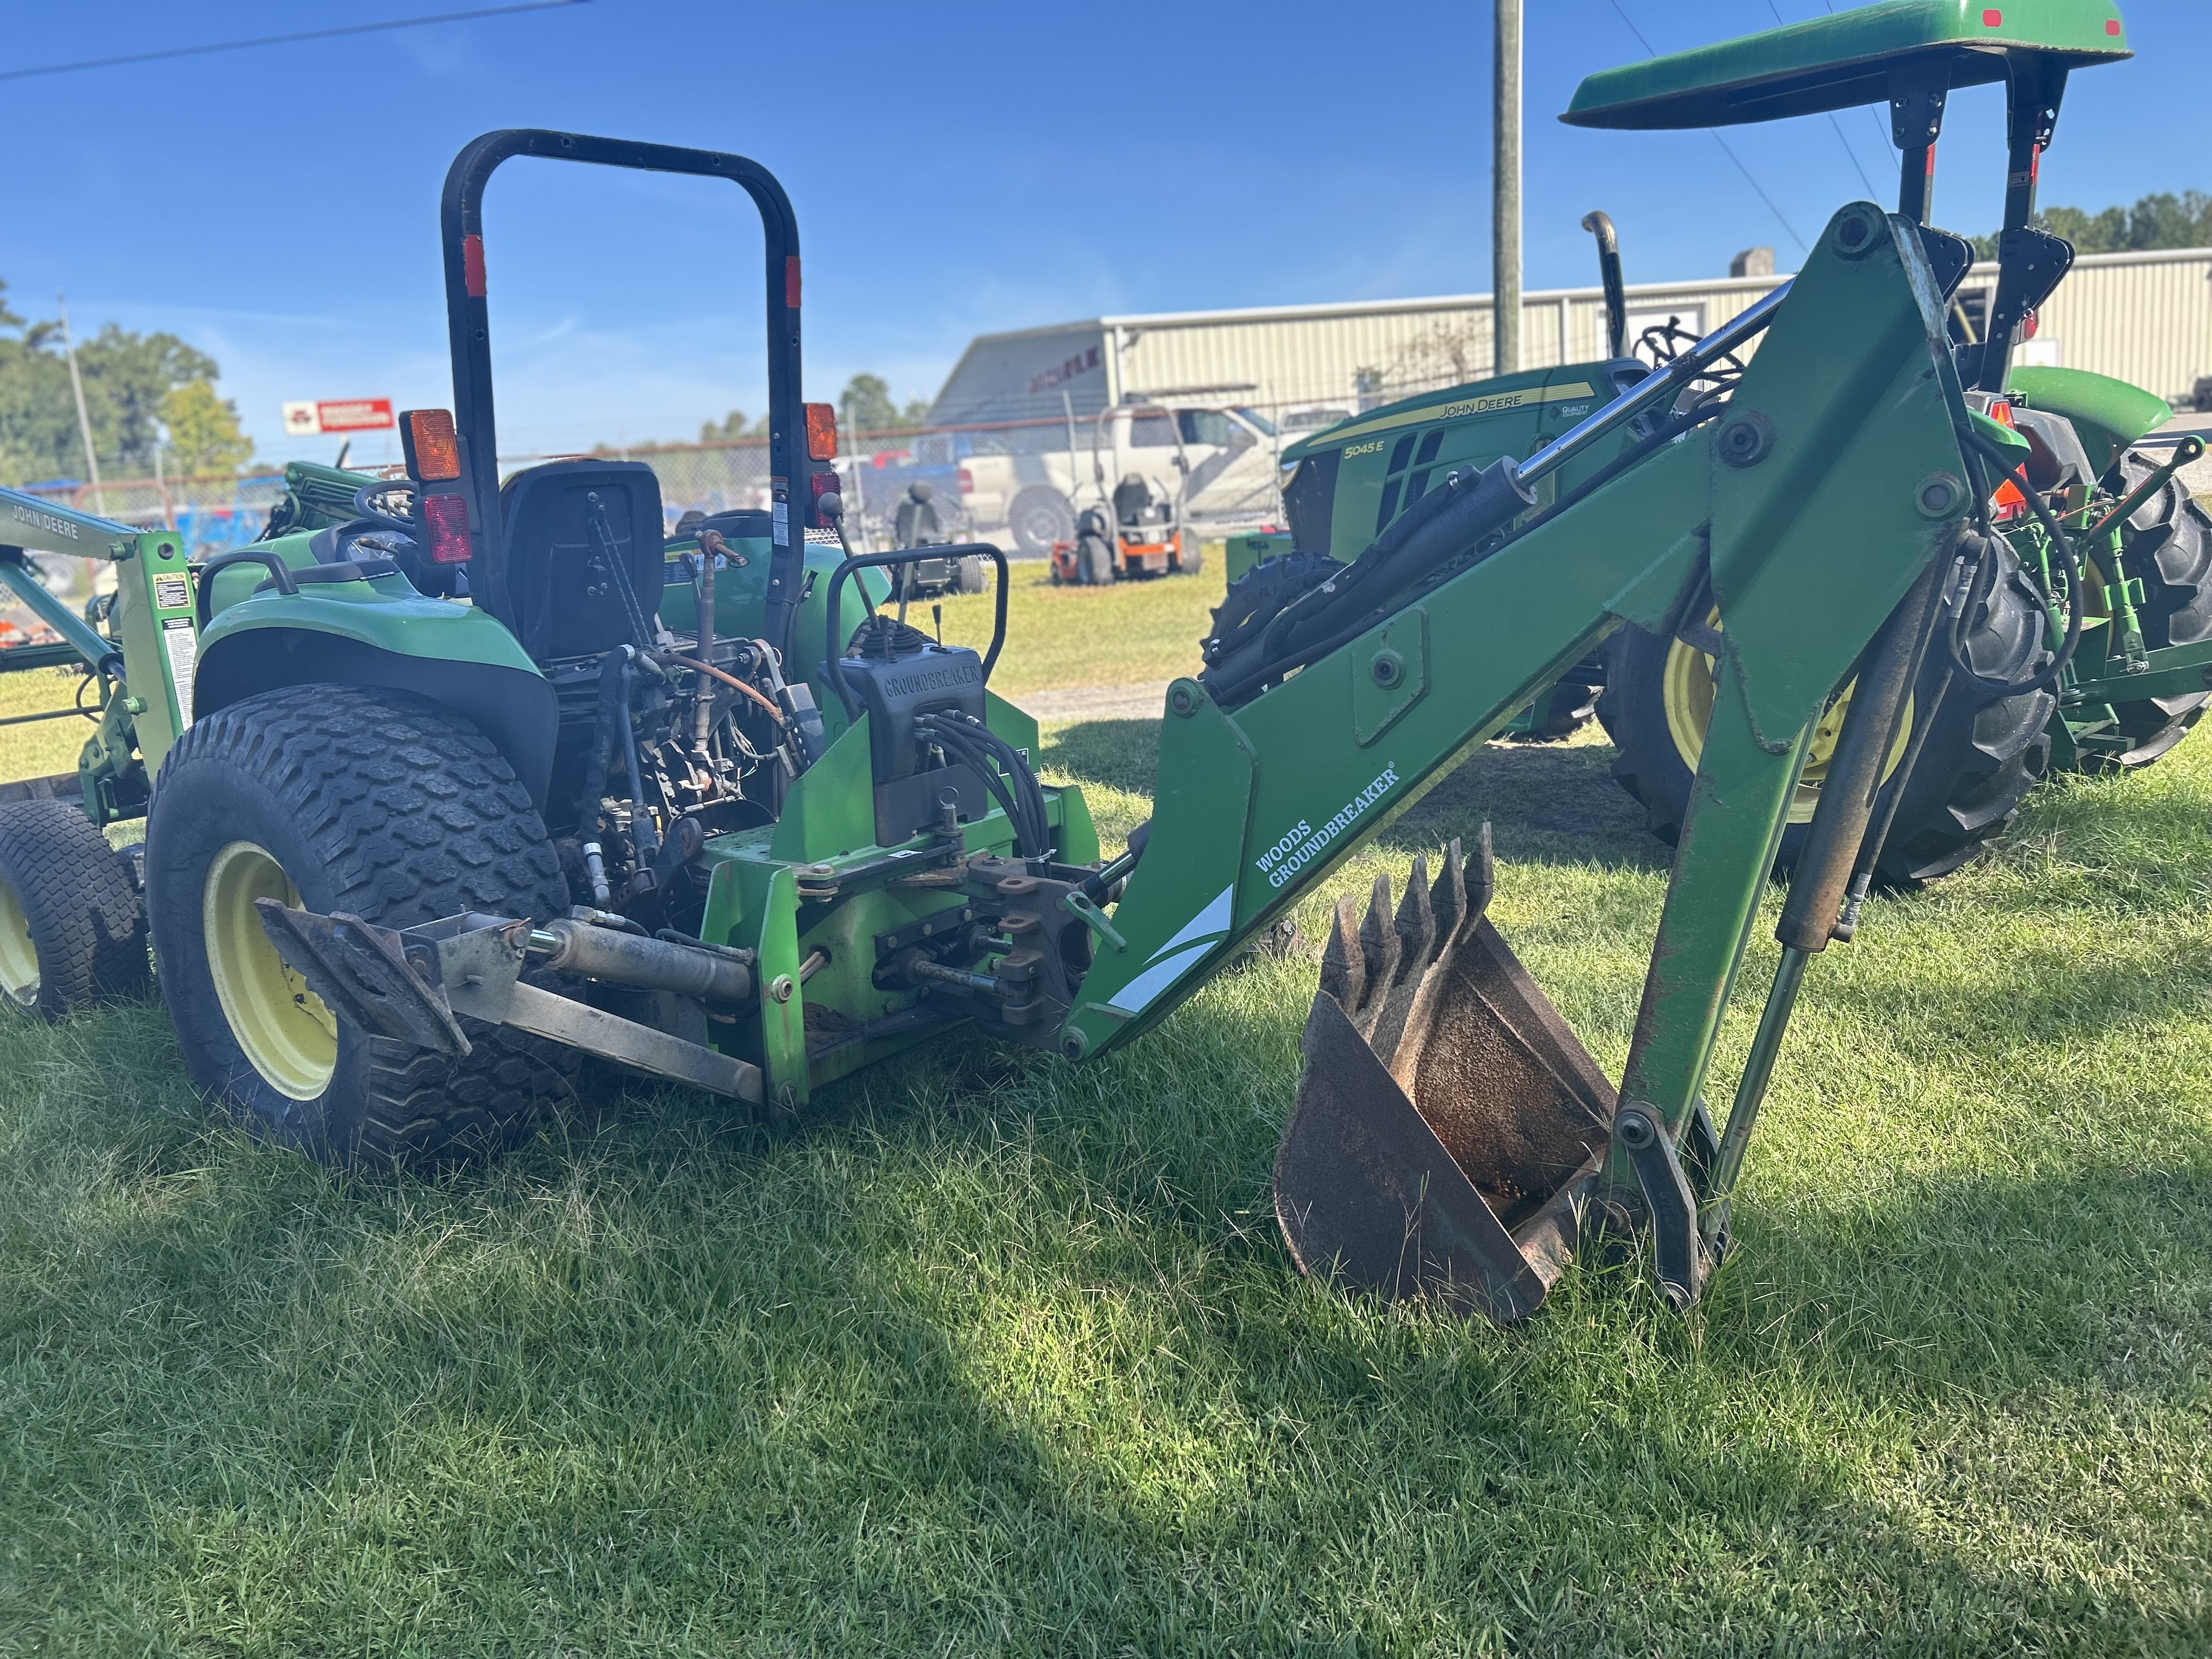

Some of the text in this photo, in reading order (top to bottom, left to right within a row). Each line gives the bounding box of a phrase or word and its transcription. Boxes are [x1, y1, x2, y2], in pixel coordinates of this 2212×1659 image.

[1440, 395, 1522, 418] JOHN DEERE
[1562, 404, 1589, 413] QUALITY
[1344, 442, 1375, 459] 5045
[12, 504, 78, 540] JOHN DEERE
[885, 665, 979, 698] GROUNDBREAKER
[1255, 819, 1311, 872] WOODS
